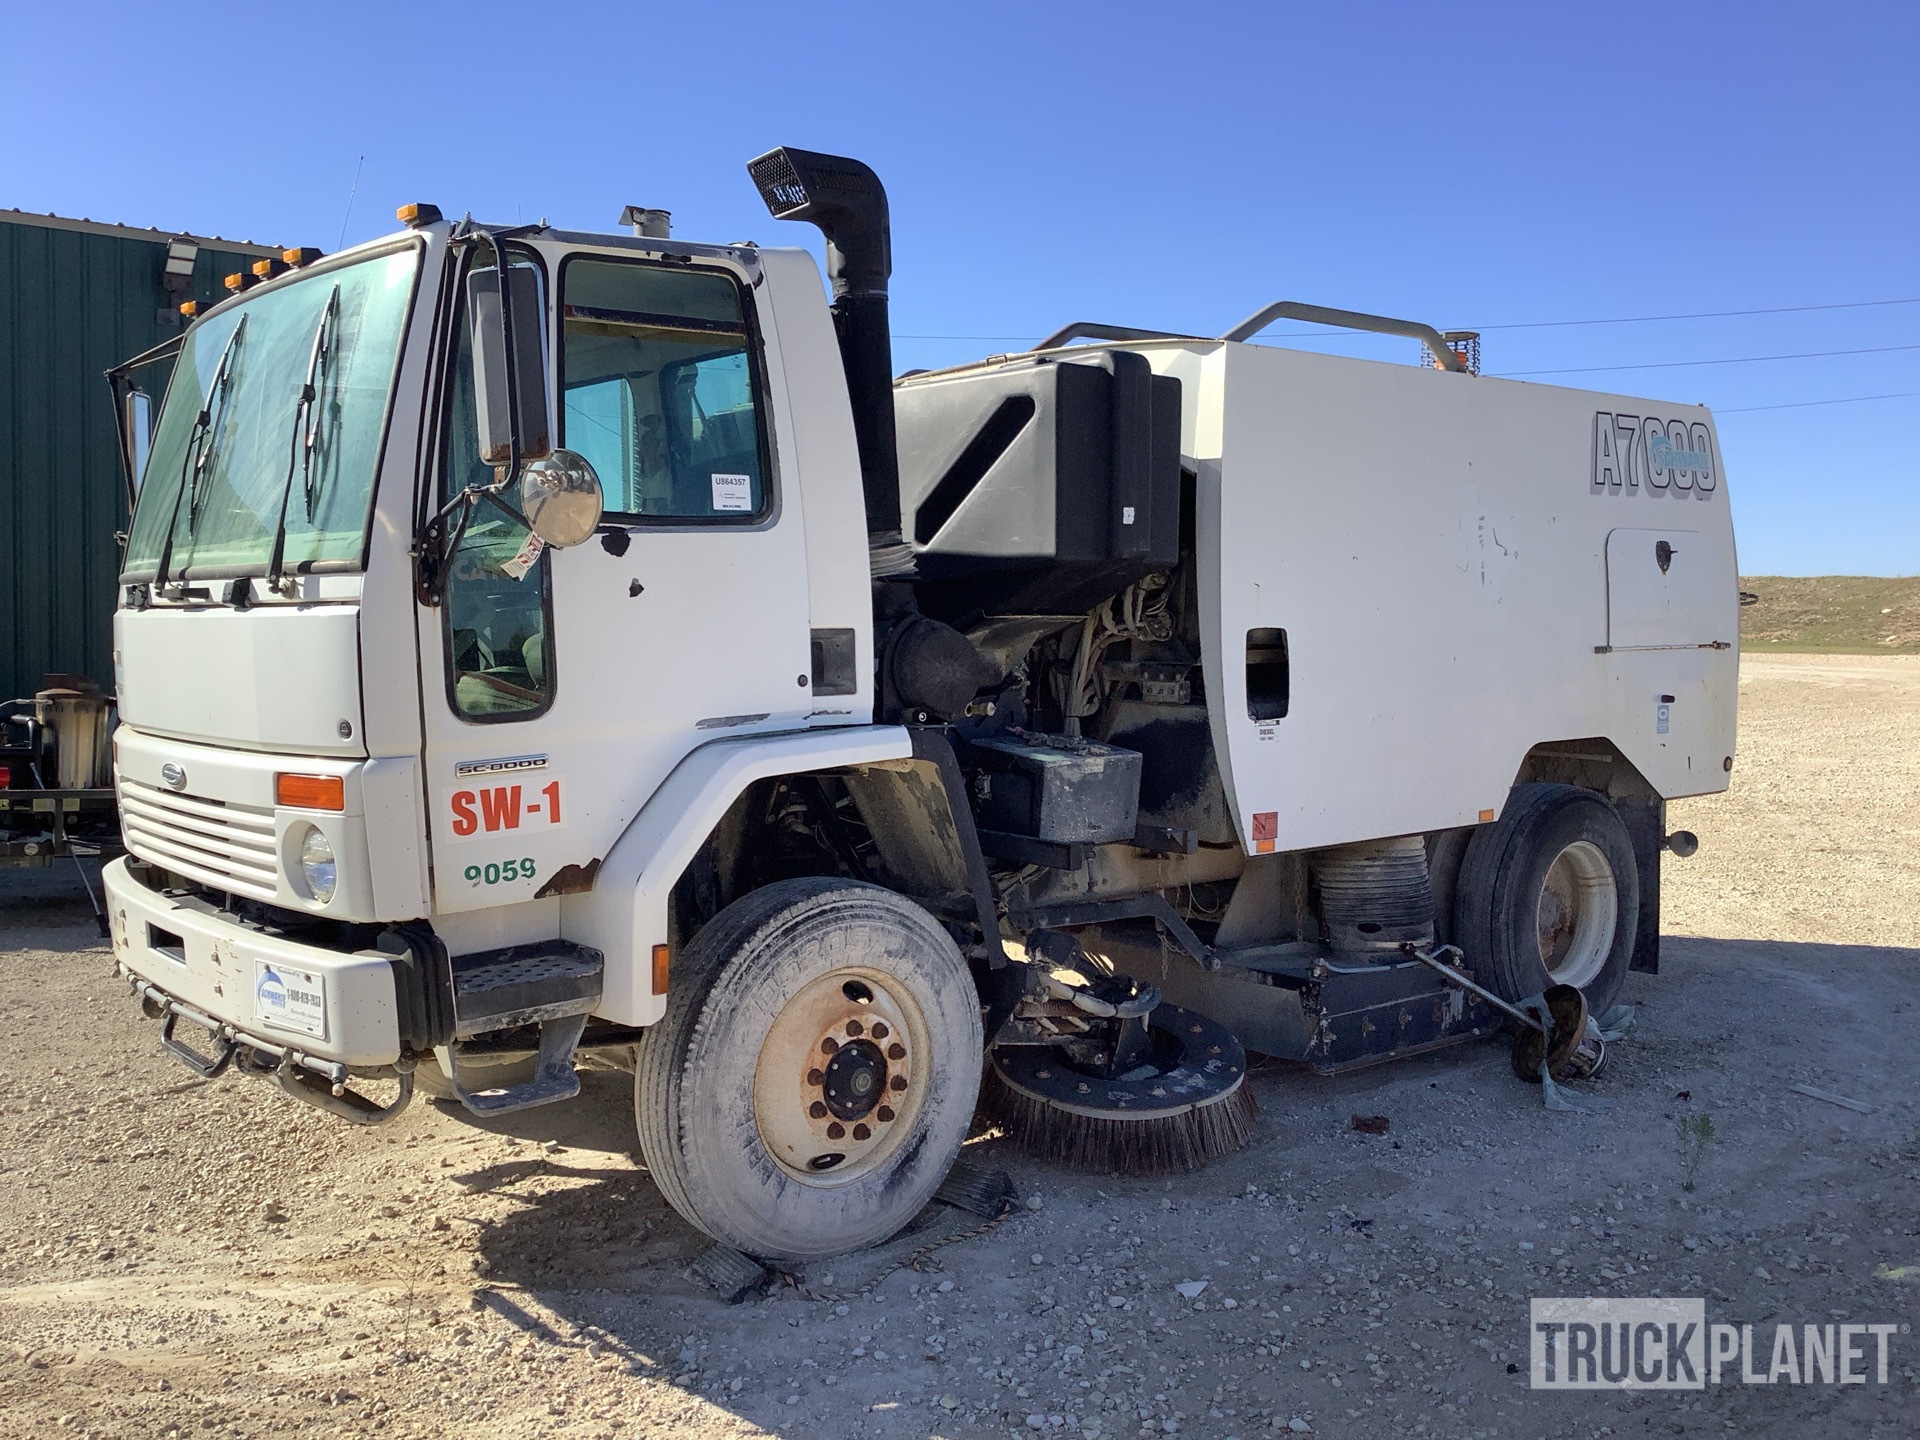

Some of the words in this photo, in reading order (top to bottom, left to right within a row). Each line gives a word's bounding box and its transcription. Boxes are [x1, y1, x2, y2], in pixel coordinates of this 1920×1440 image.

[1592, 411, 1717, 495] A7000
[715, 477, 746, 486] U864357
[451, 780, 561, 837] SW-1
[464, 857, 537, 888] 9059
